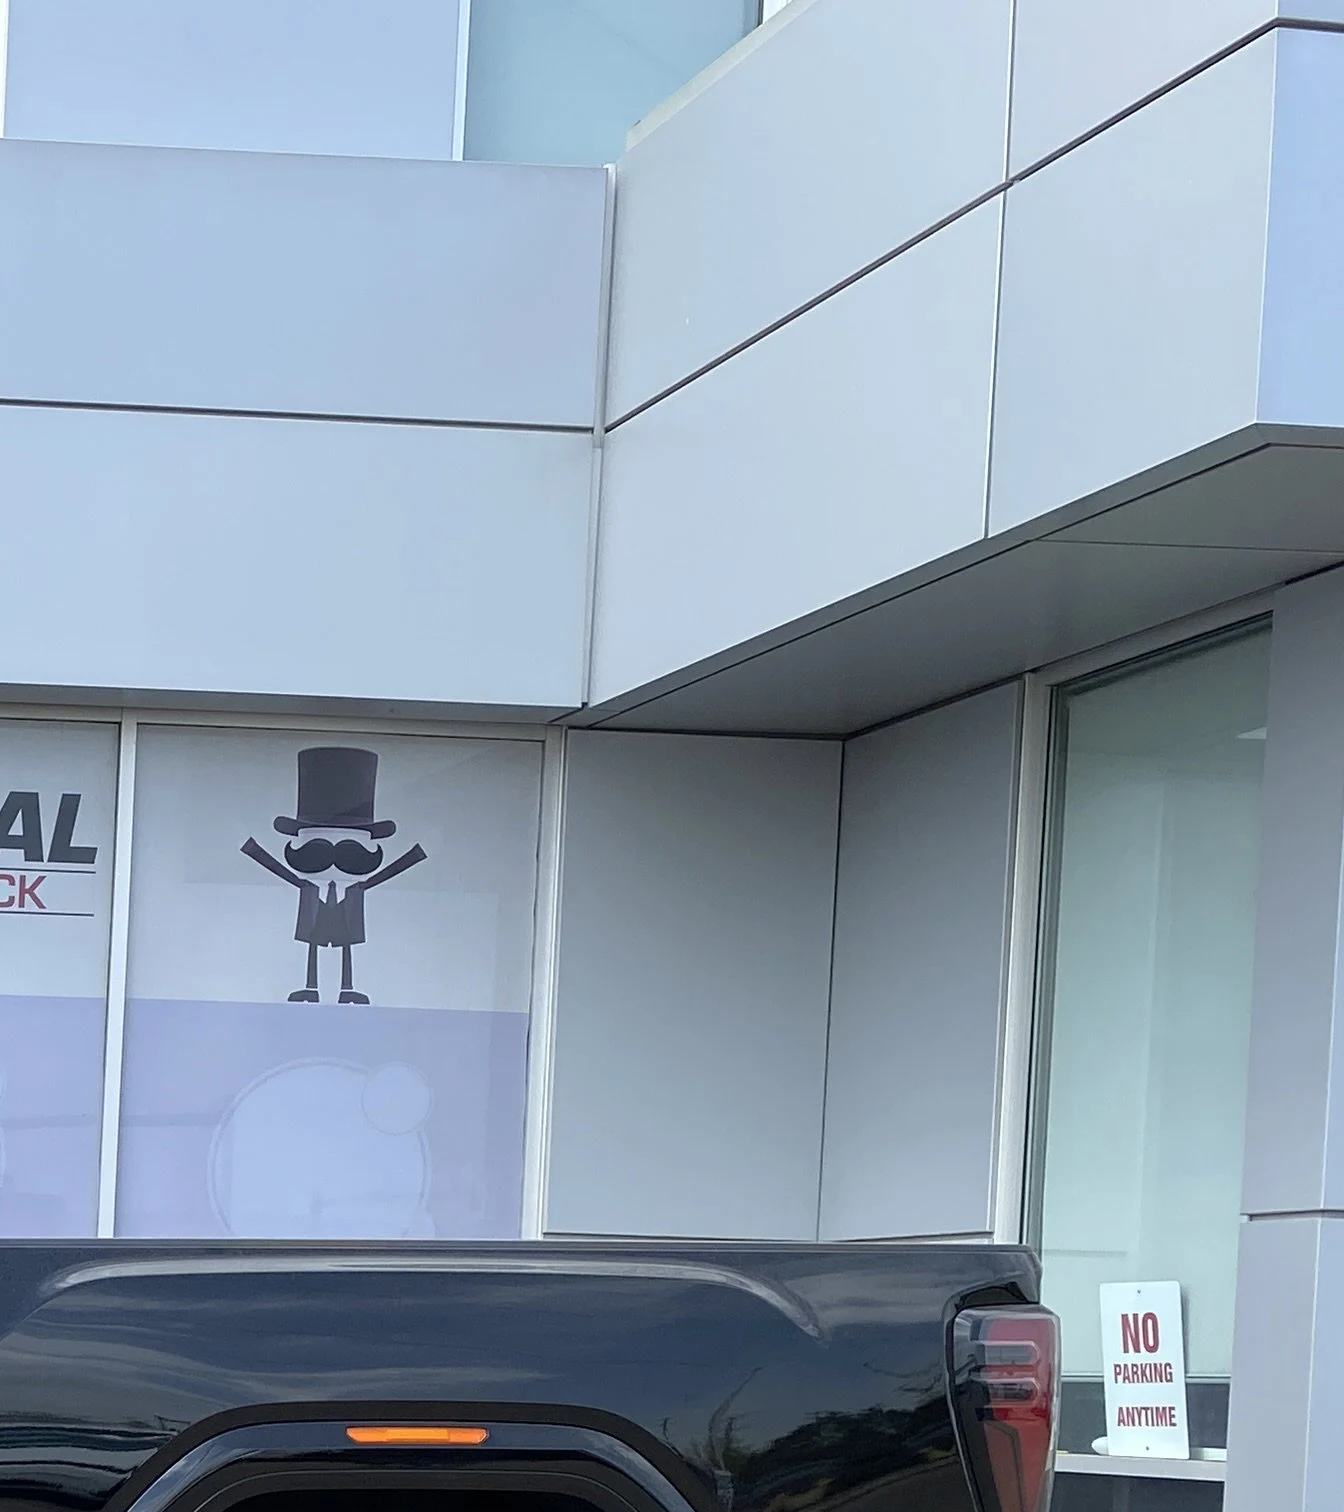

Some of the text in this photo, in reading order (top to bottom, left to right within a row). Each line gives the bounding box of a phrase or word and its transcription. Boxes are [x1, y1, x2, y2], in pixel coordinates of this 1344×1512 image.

[1120, 1312, 1160, 1354] NO
[1113, 1362, 1174, 1384] PARKING
[1116, 1406, 1177, 1427] ANYTIME
